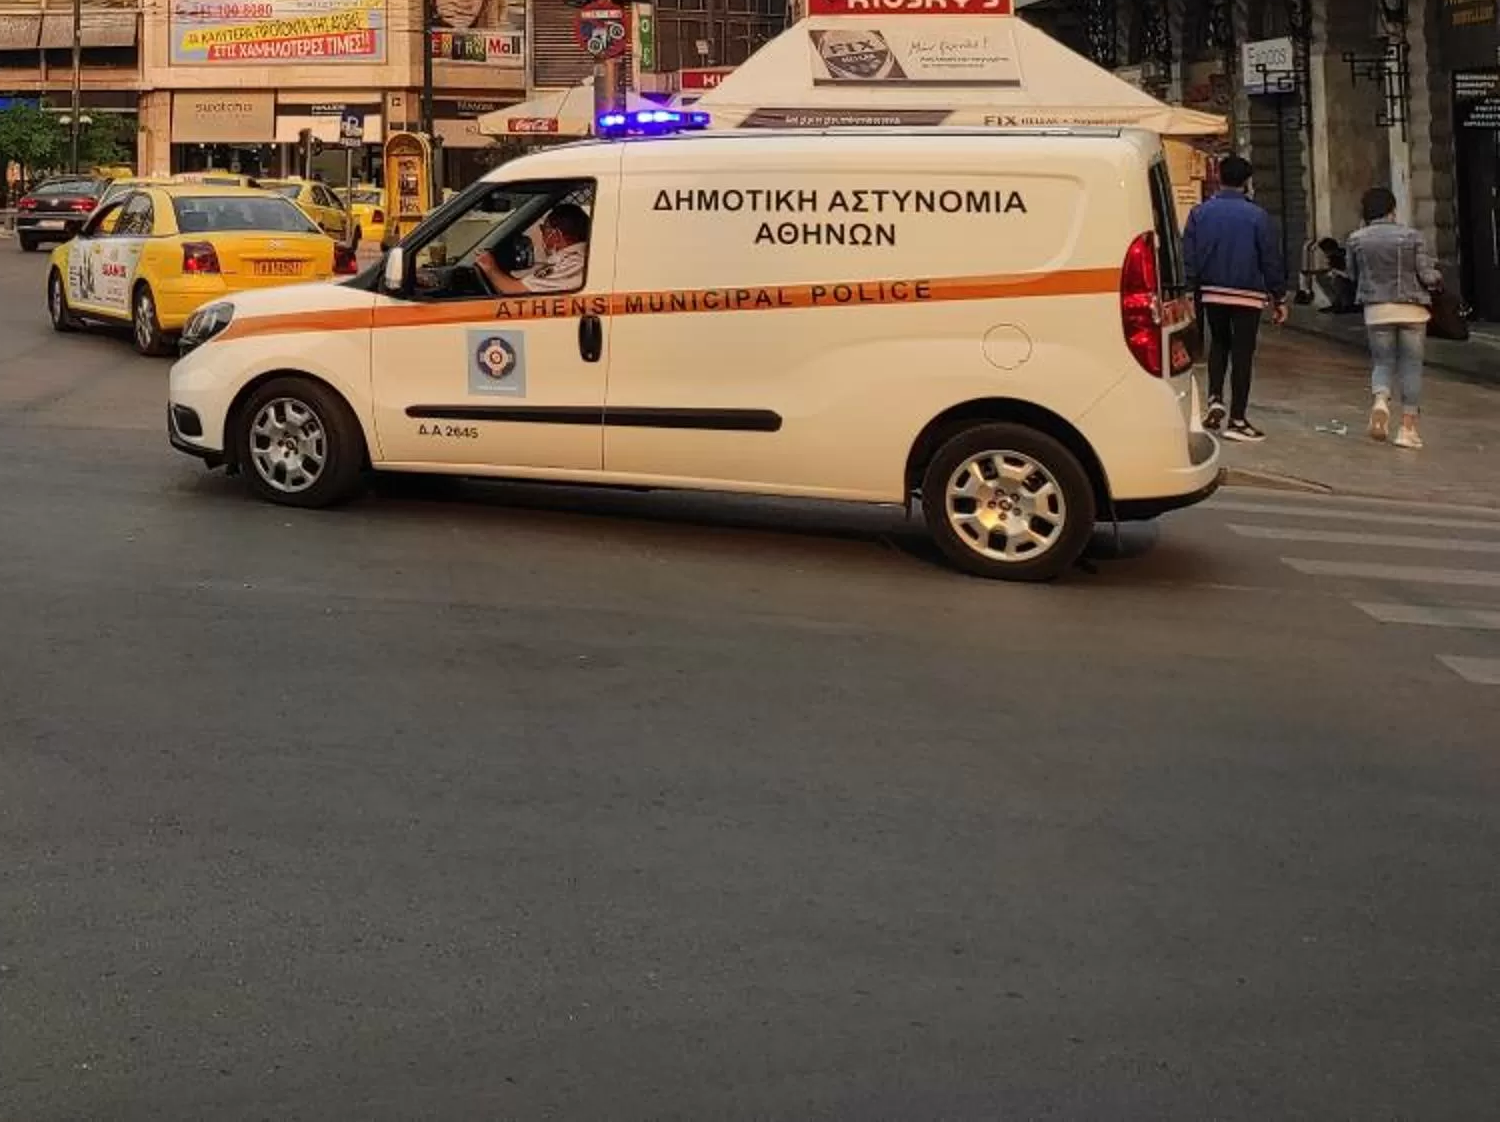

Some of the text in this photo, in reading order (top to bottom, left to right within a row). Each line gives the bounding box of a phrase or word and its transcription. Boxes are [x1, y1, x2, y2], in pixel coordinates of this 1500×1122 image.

[488, 36, 521, 55] Mall
[652, 189, 1028, 214] ΔΗΜΟΤΙΚΗ ΑΣΤΥΝΟΜΙΑ
[754, 222, 897, 246] ΑΘΗΝΩΝ
[496, 279, 932, 318] ATHENS MUNICIPAL POLICE
